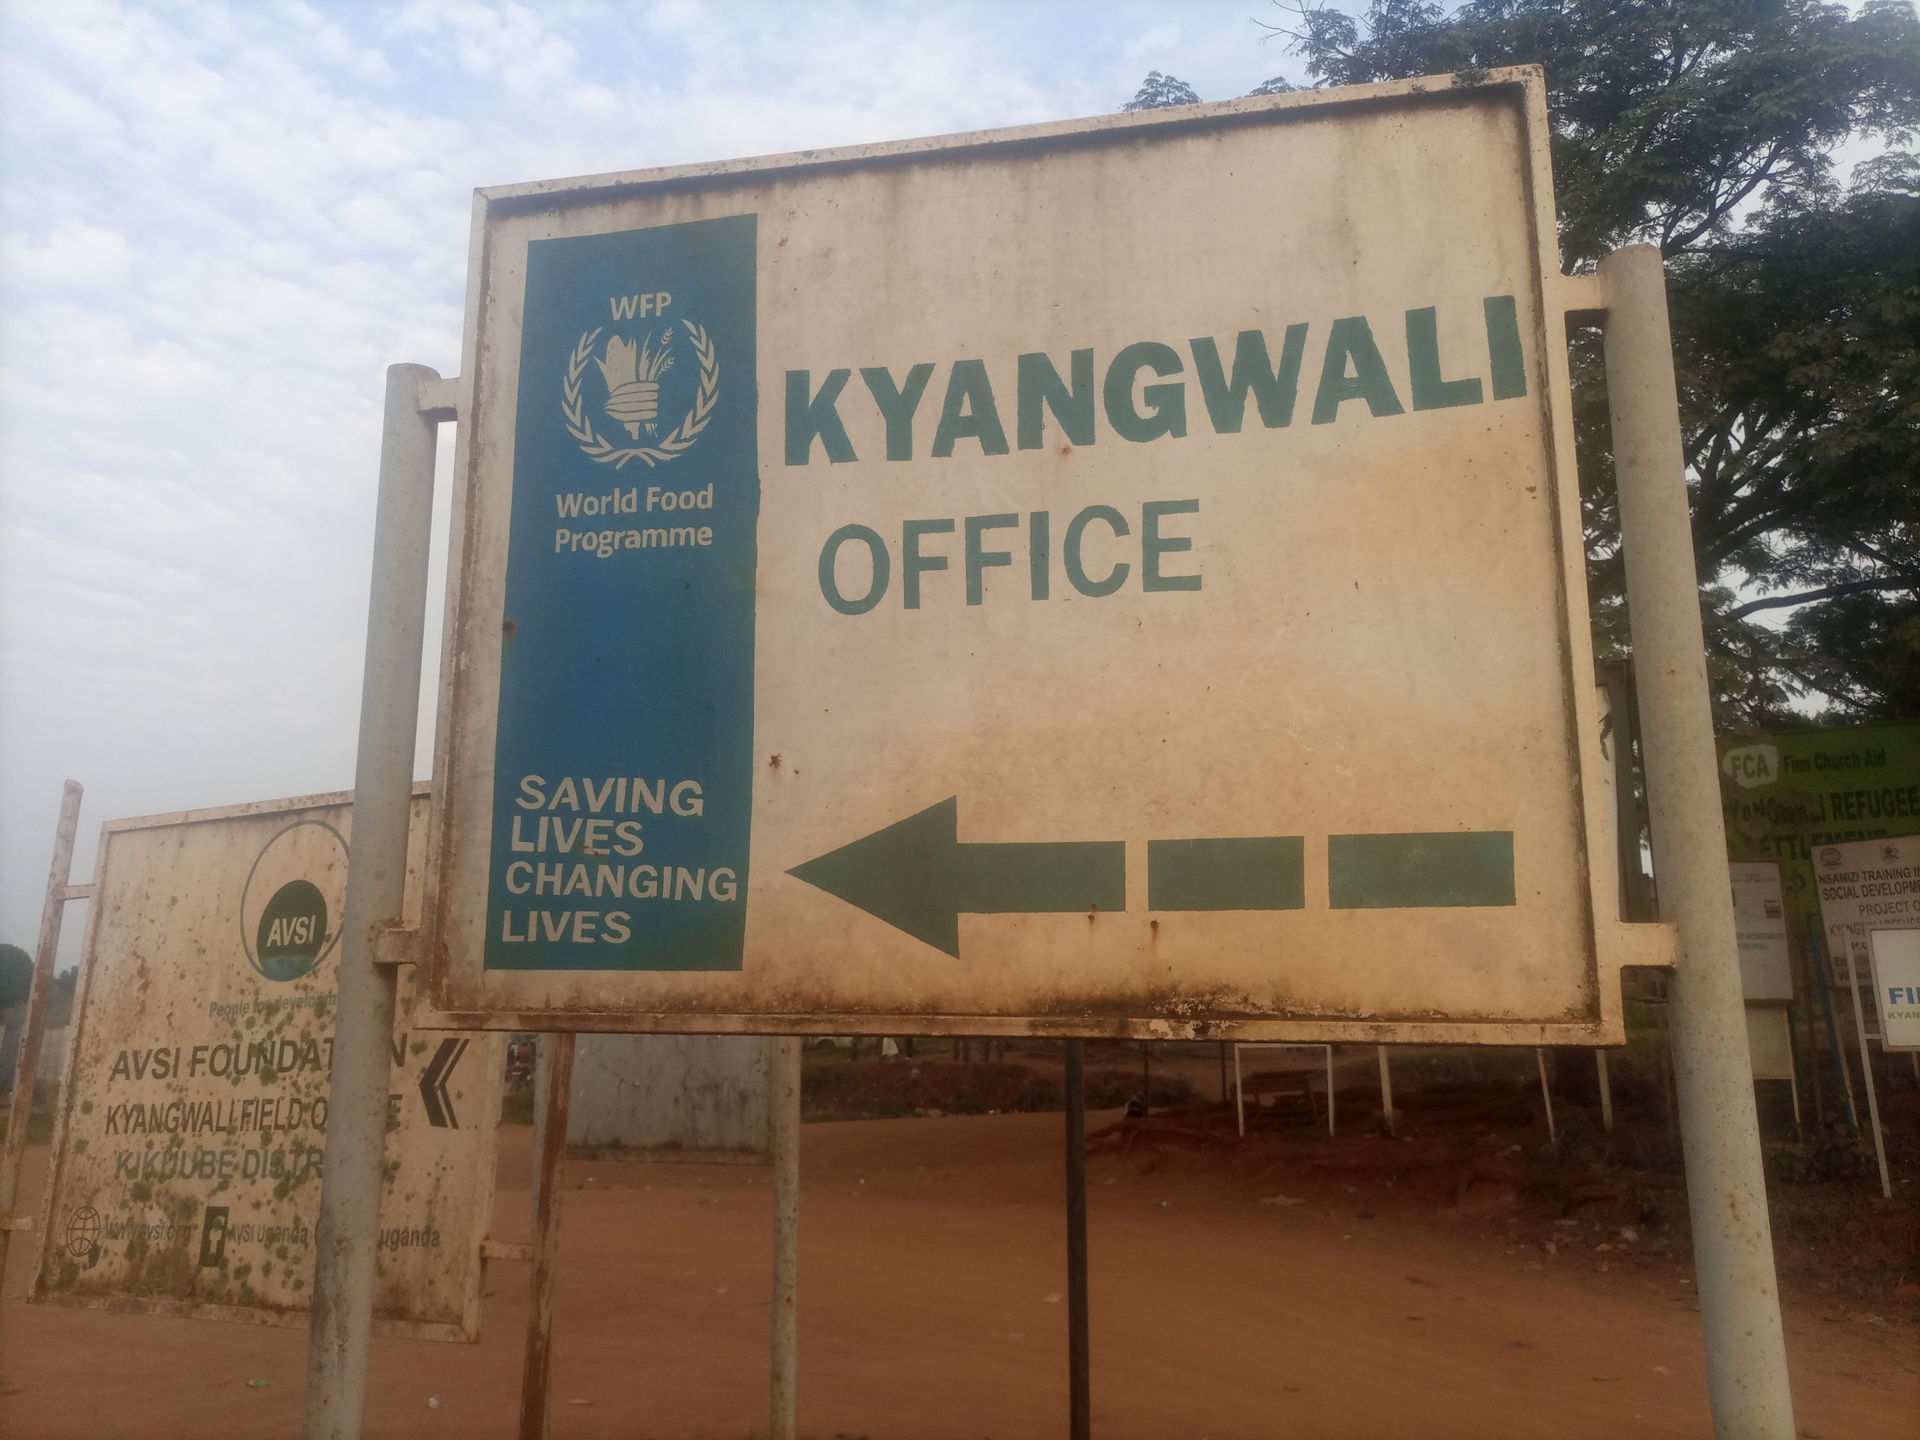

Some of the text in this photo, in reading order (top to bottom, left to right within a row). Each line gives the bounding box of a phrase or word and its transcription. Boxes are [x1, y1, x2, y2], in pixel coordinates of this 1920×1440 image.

[610, 291, 673, 321] WFP
[784, 295, 1528, 466] KYANGWALI
[556, 483, 714, 518] World Food
[555, 525, 713, 558] Programme
[817, 498, 1203, 615] OFFICE
[1731, 753, 1770, 779] FCA
[1814, 751, 1860, 770] Church
[1865, 749, 1886, 767] Aid
[515, 774, 704, 816] SAVING
[1830, 786, 1920, 821] REFUGEE
[511, 815, 644, 856] LIVES
[506, 860, 737, 901] CHANGING
[1862, 867, 1911, 881] TRAINING
[1822, 886, 1860, 901] SOCIAL
[1859, 900, 1910, 916] PROJECT
[266, 915, 316, 947] AVSI
[502, 910, 632, 944] LIVES
[209, 999, 250, 1017] People
[109, 1033, 408, 1081] AVSI FOUNDATN
[105, 1099, 235, 1135] KYANGWALI
[239, 1097, 304, 1131] FIELD
[241, 1148, 324, 1180] DISTR
[379, 1225, 440, 1251] uganda
